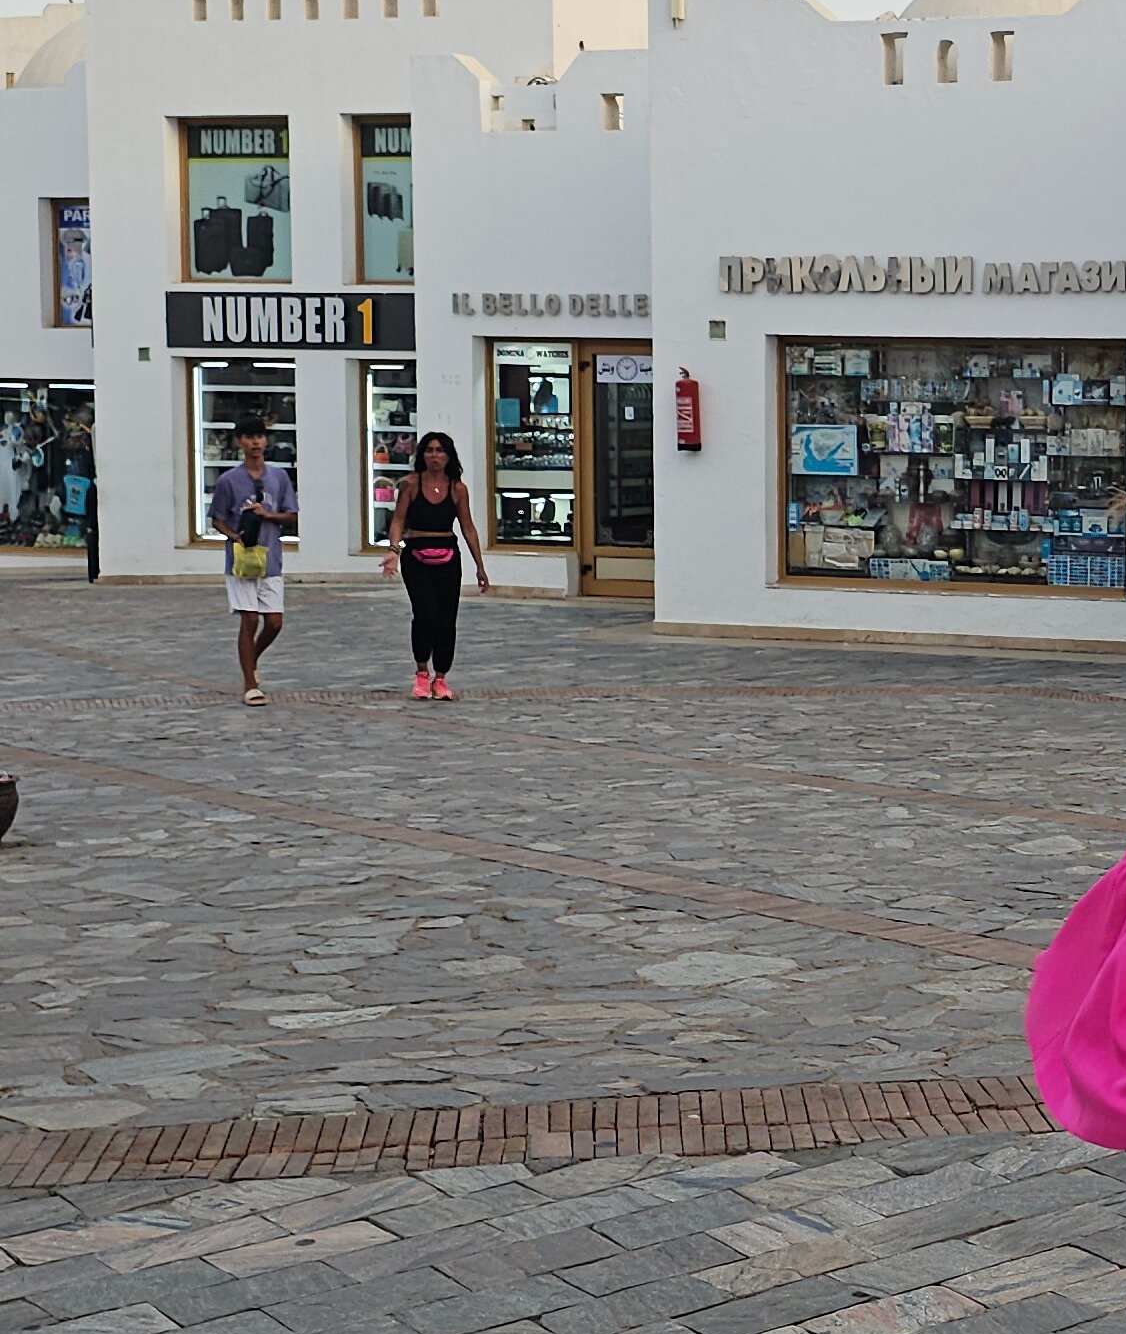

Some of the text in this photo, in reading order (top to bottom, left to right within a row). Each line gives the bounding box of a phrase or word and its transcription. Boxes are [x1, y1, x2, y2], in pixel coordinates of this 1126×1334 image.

[201, 128, 275, 155] NUMBER
[452, 292, 650, 318] IL BELLO DELLE
[202, 295, 374, 345] NUMBER 1
